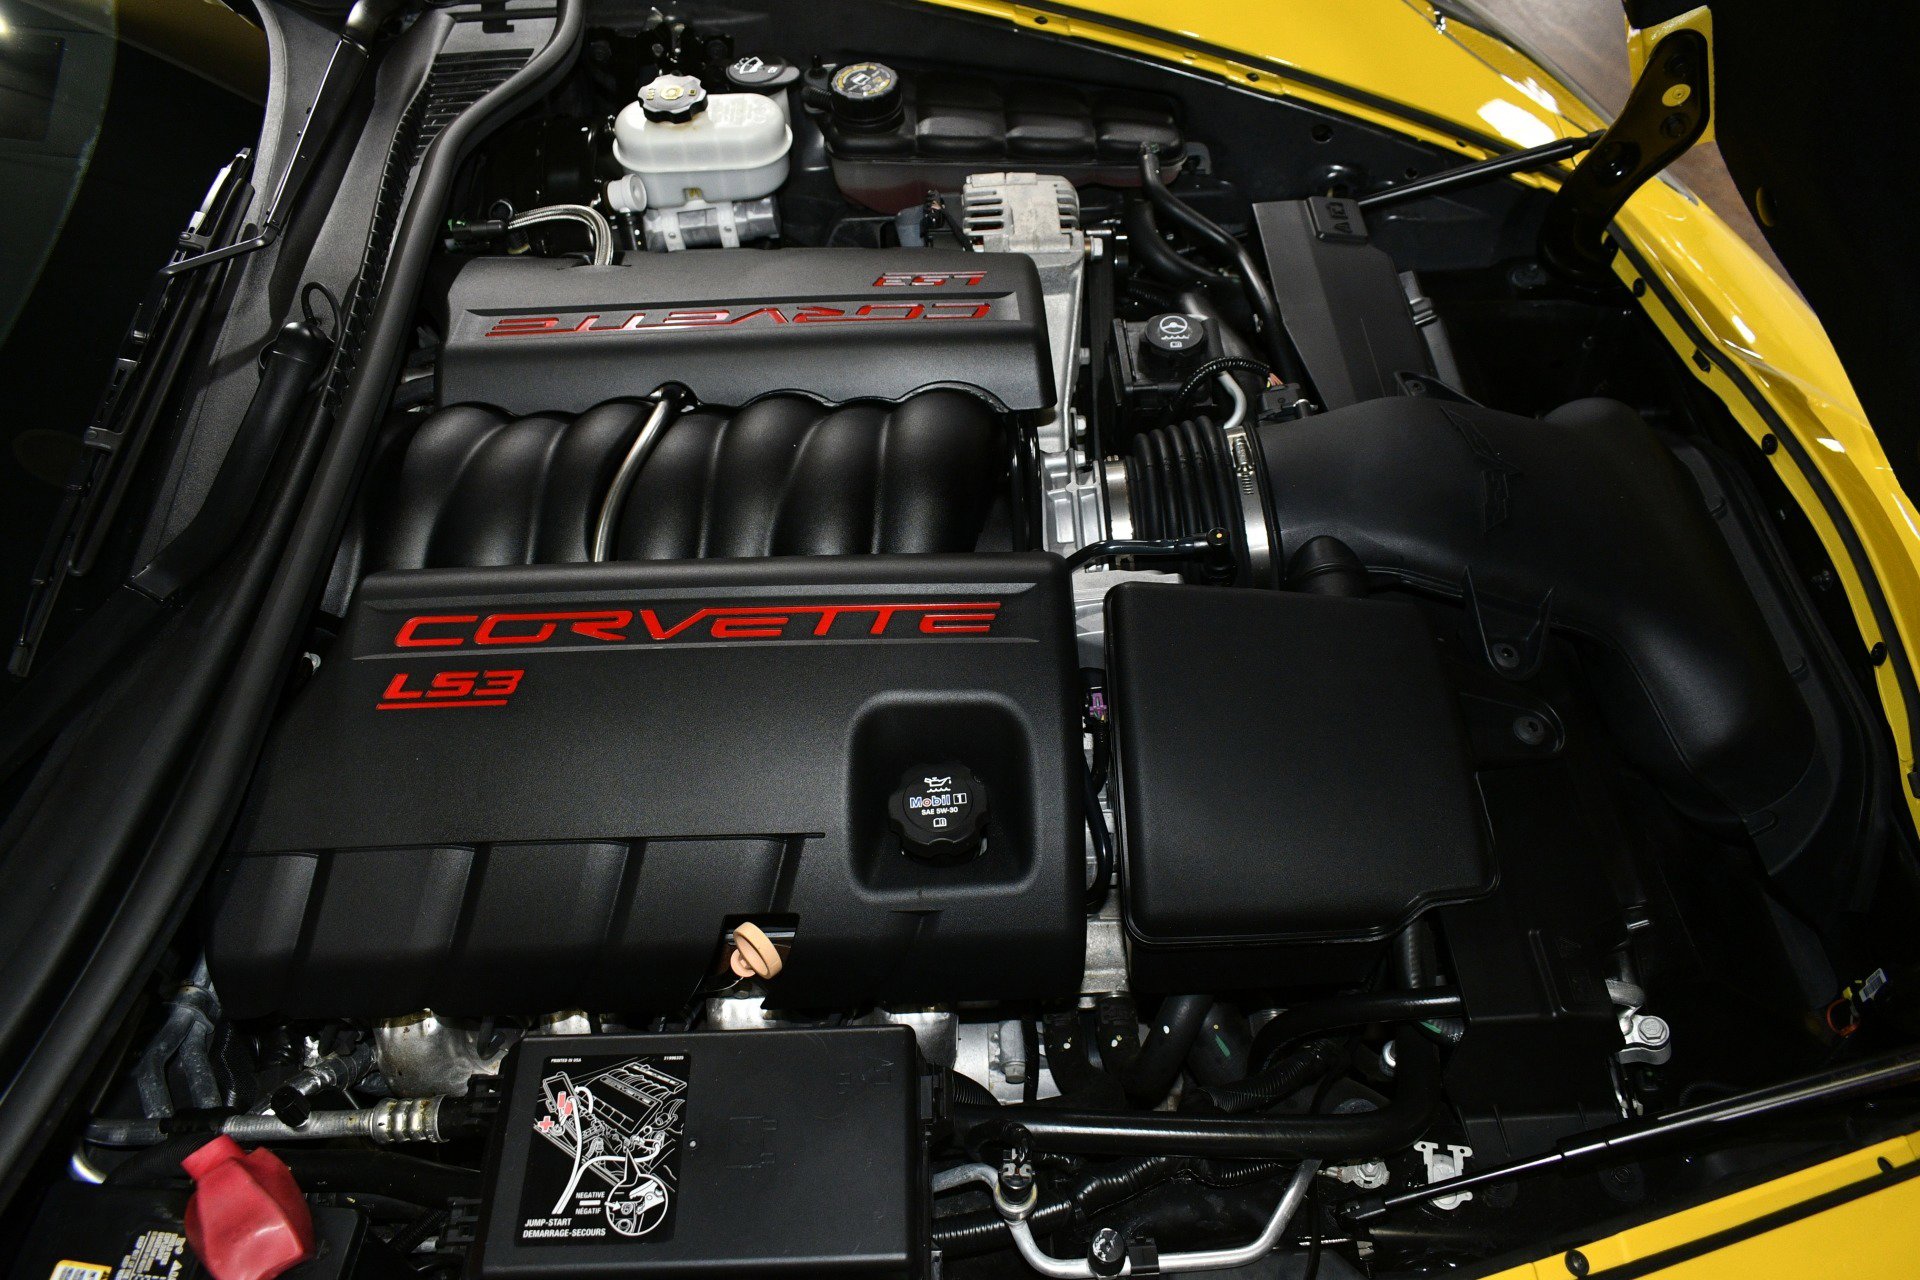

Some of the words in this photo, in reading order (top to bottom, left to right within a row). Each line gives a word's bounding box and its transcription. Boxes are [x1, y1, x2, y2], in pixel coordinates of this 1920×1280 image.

[873, 273, 986, 288] LS3
[484, 303, 991, 338] CORVETTE
[394, 601, 1002, 648] CORVETTE
[382, 668, 526, 700] LS3
[909, 795, 951, 808] Mobil
[921, 808, 935, 816] SAE
[936, 806, 959, 815] 5W-30
[575, 1191, 606, 1200] NEGATIVE
[575, 1206, 602, 1216] NÉGATIF
[524, 1217, 573, 1228] JUMP-START
[522, 1227, 607, 1239] DEMARRAGE-SECOURS
